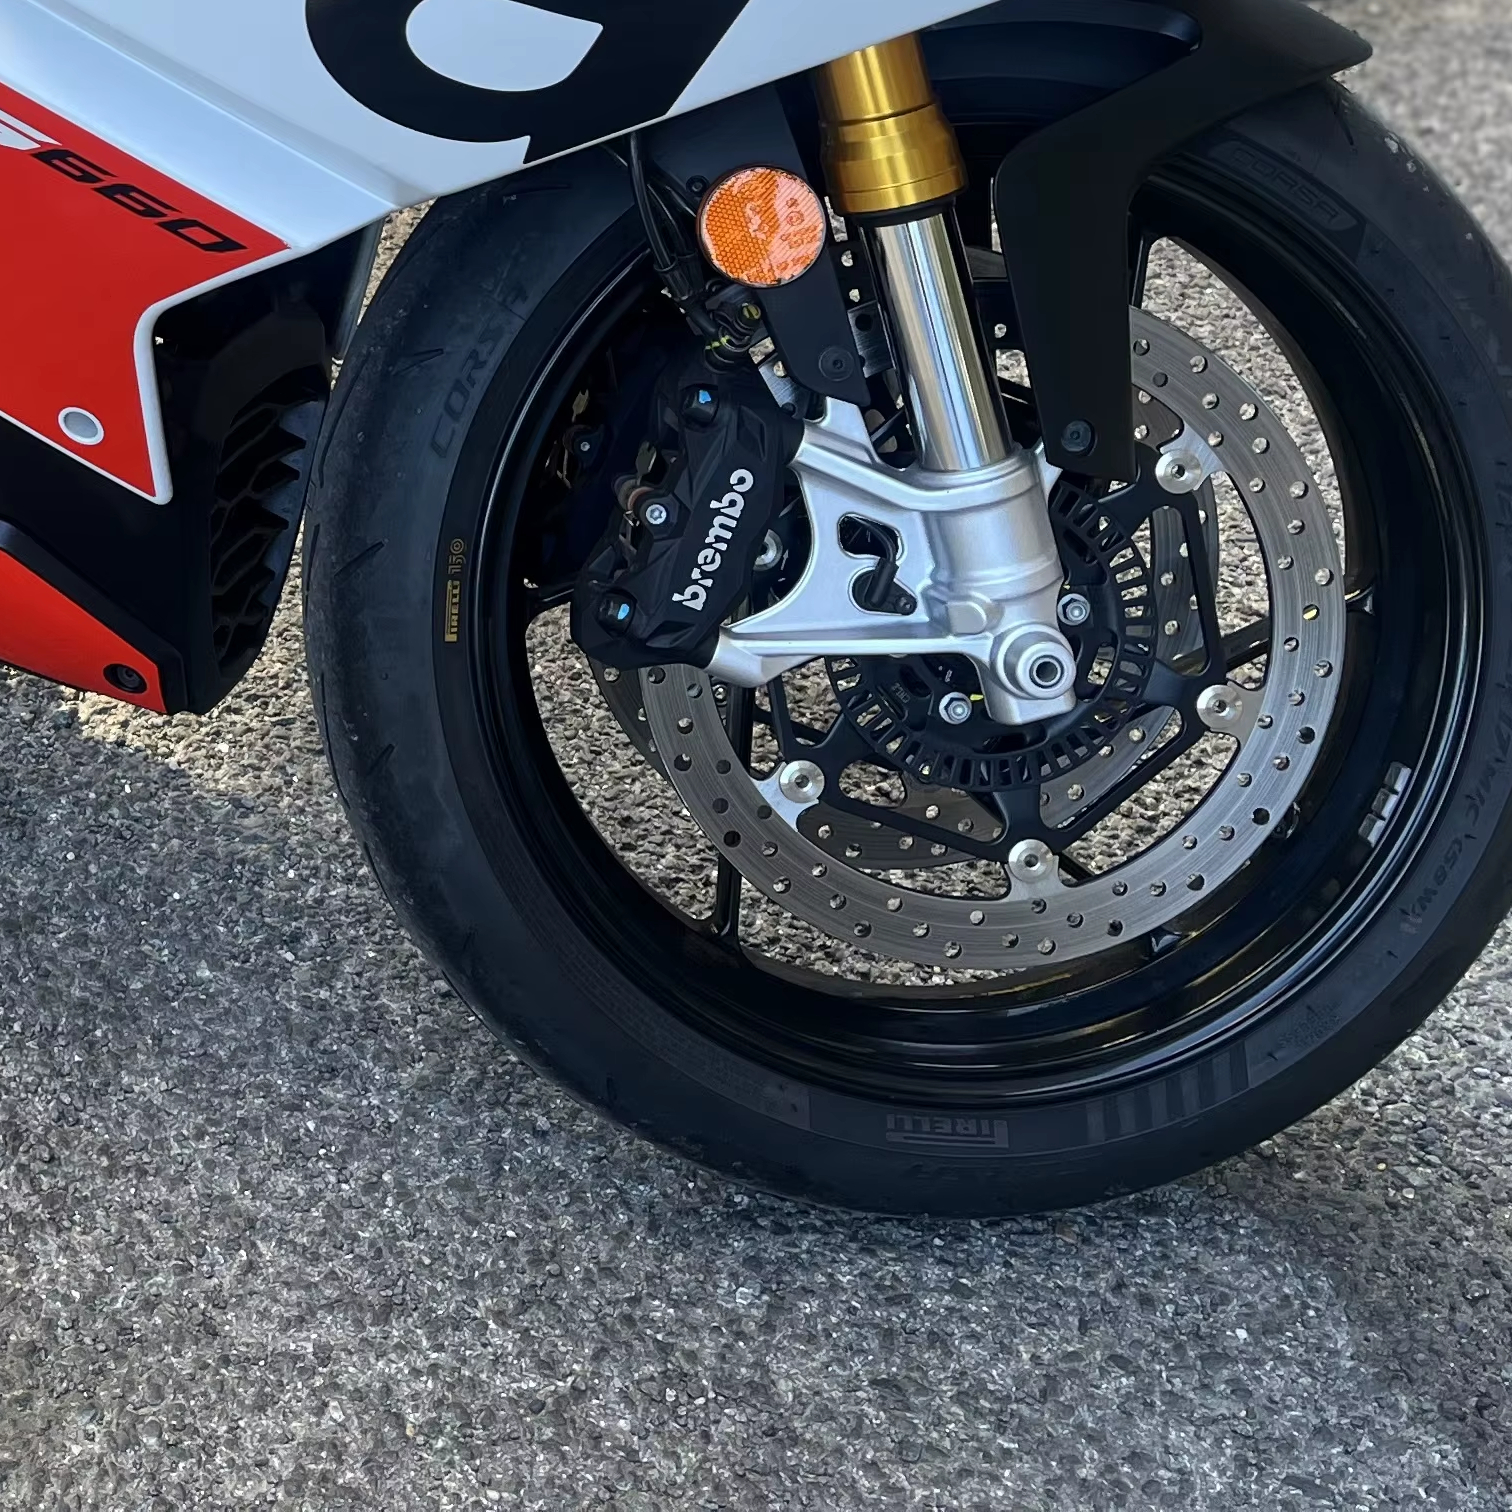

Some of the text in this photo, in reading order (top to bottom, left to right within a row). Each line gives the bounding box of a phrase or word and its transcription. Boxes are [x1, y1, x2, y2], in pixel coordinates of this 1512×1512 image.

[31, 148, 247, 253] 660
[672, 469, 754, 611] brembo
[444, 580, 461, 643] PIRELLI
[886, 1112, 1009, 1148] PIRELLI
